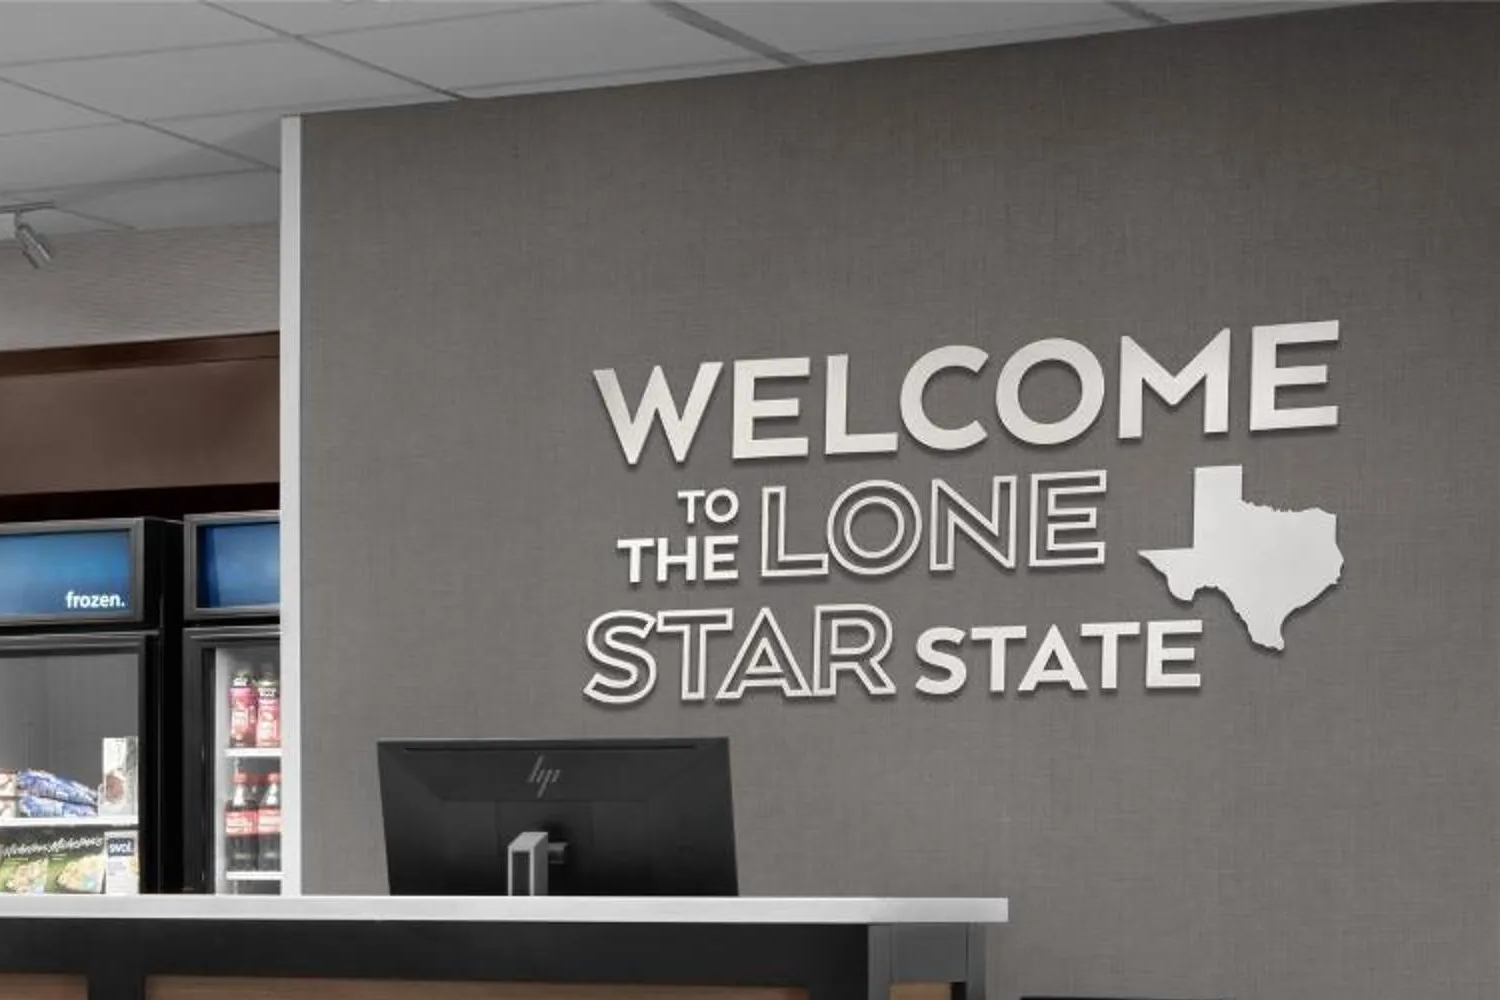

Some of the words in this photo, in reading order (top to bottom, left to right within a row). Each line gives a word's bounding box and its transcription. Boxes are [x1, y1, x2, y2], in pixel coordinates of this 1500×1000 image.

[593, 319, 1339, 465] WELCOME
[616, 534, 740, 583] THE
[761, 469, 1108, 578] LONE
[677, 488, 740, 524] TO
[65, 590, 125, 609] frozen.
[583, 603, 898, 704] STAR
[915, 618, 1204, 695] STATE
